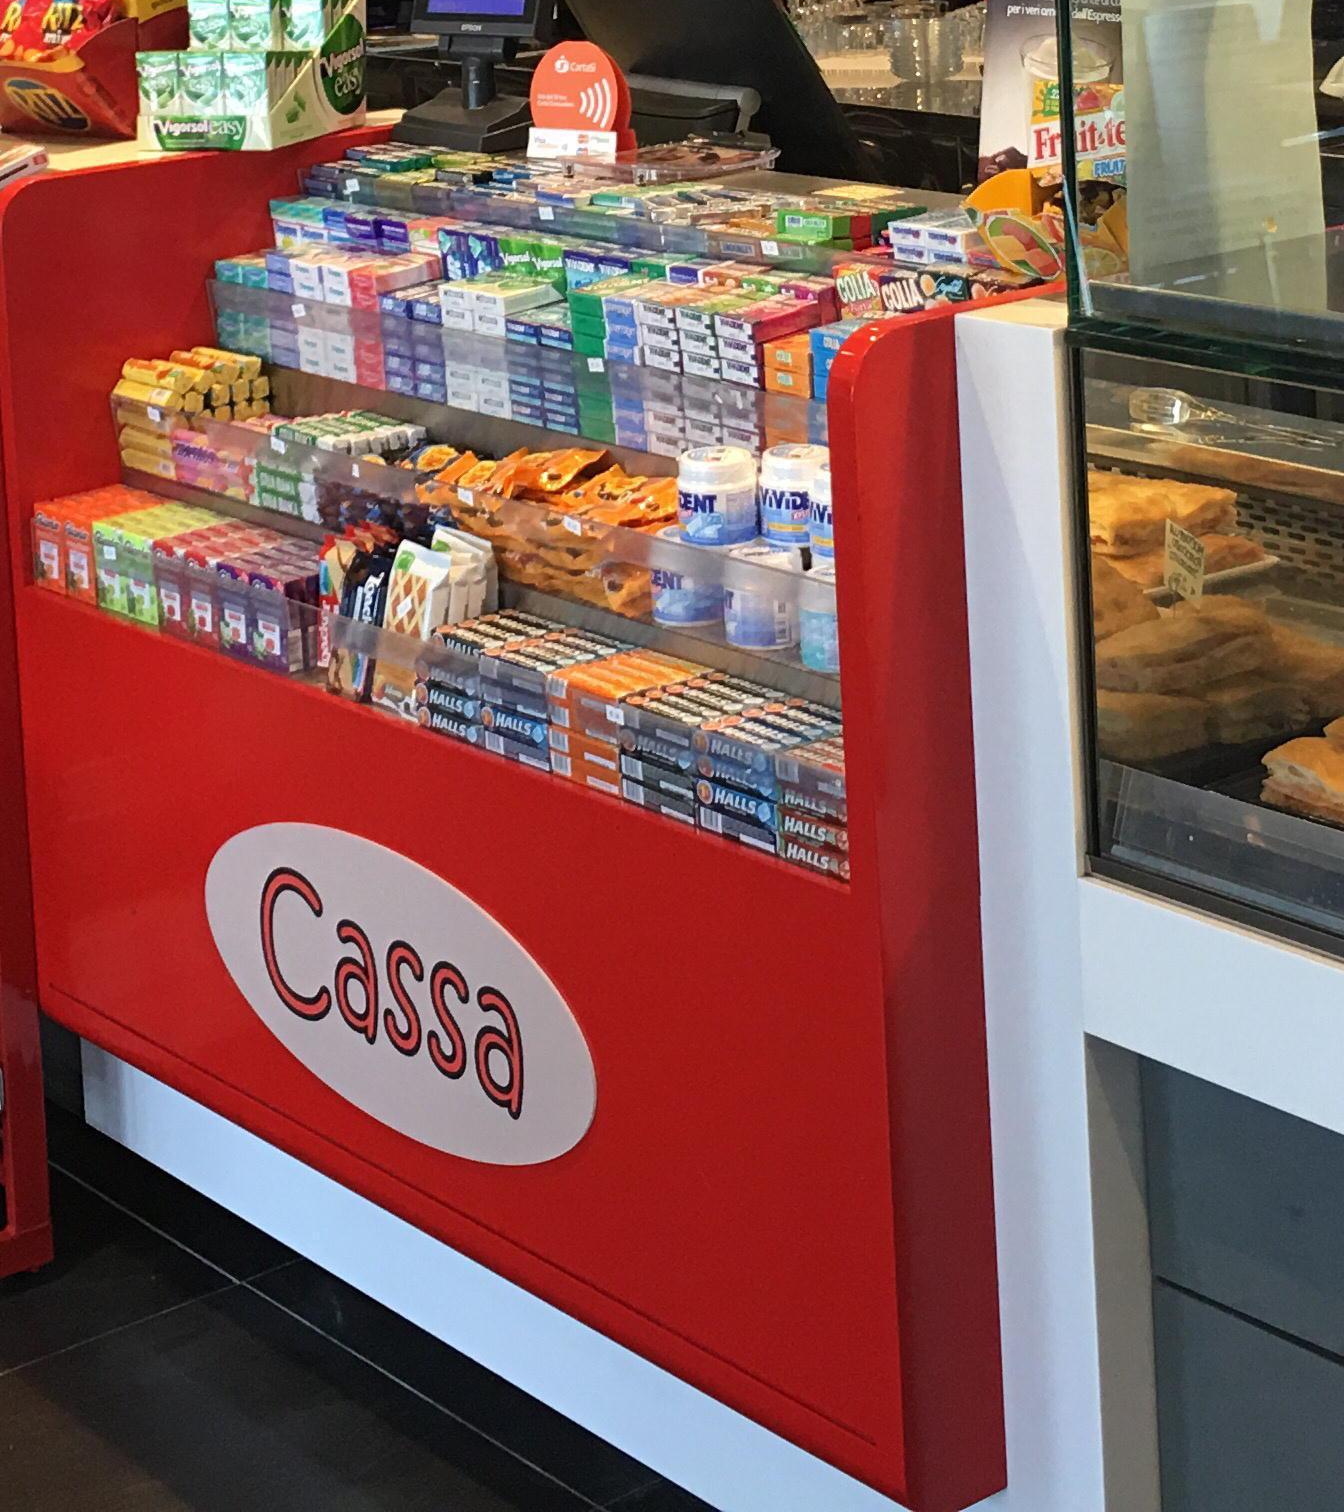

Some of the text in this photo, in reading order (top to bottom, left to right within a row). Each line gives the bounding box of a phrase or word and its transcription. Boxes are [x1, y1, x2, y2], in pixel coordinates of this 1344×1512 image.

[334, 71, 362, 96] easy
[154, 118, 246, 139] Vigorsol easy
[837, 271, 875, 304] GOLIA
[882, 279, 923, 310] GOLIA
[429, 692, 463, 711] HALLS
[432, 714, 466, 736] HALLS
[496, 713, 532, 736] HALLS
[711, 739, 753, 764] HALLS
[714, 788, 757, 814] HALLS
[784, 816, 827, 842] HALLS
[786, 842, 829, 869] HALLS
[259, 866, 524, 1120] Cassa
